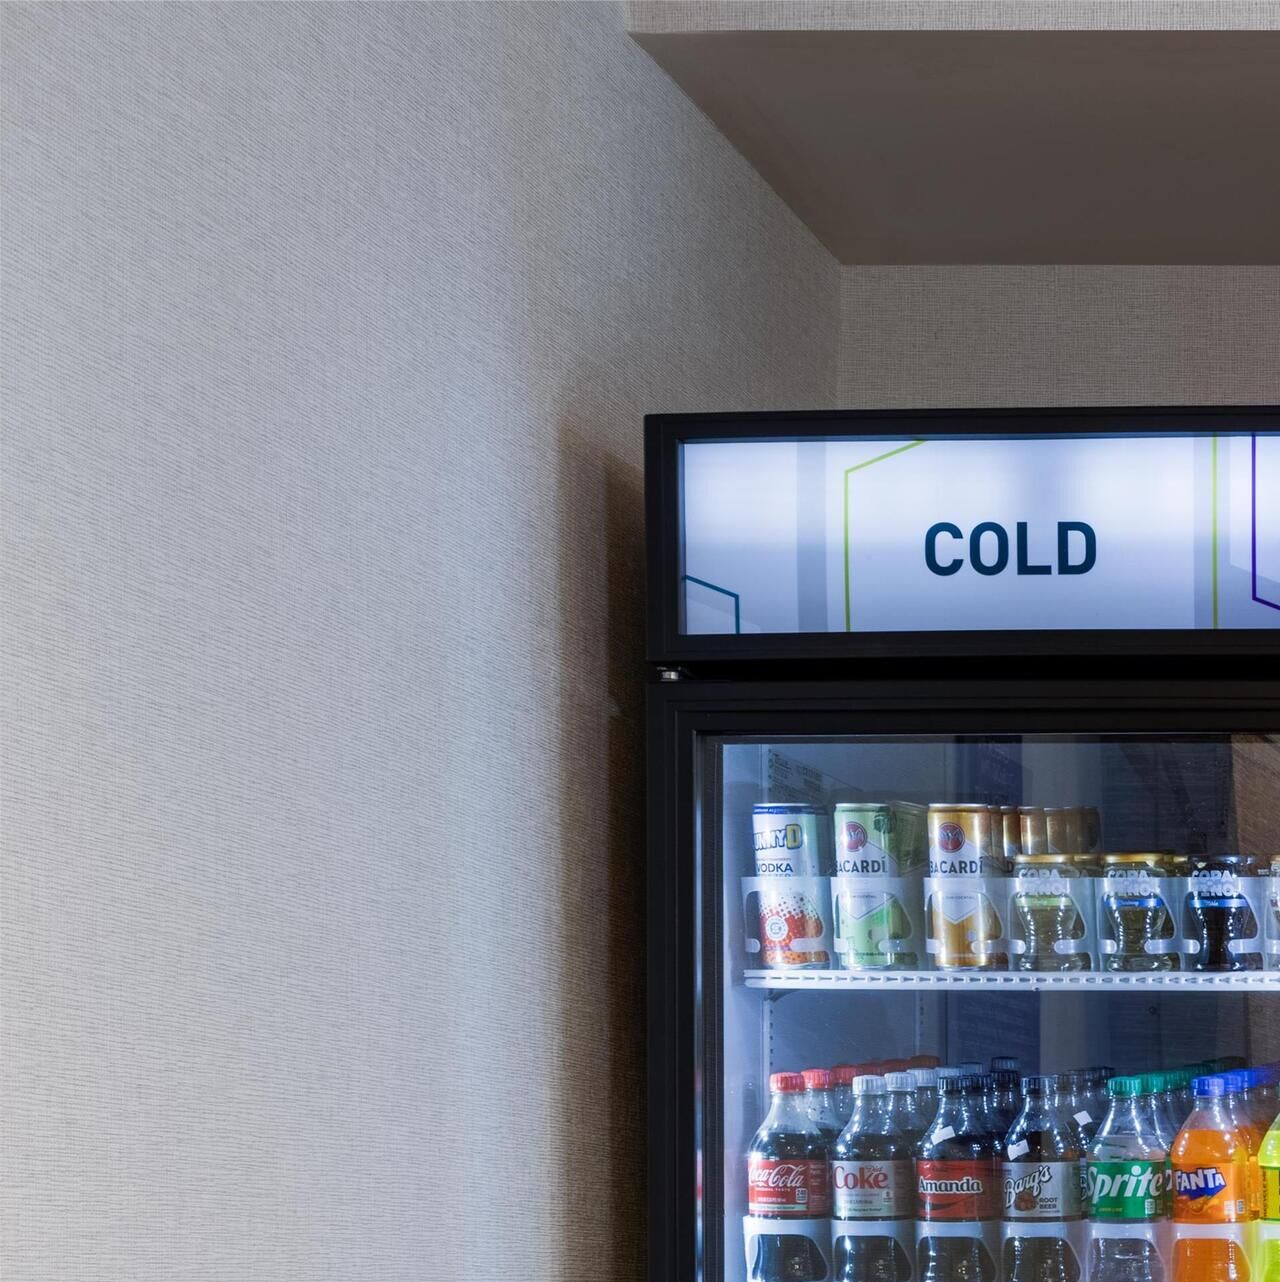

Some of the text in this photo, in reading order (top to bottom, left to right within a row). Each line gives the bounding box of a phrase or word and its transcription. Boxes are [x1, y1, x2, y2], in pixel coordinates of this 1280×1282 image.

[923, 520, 1098, 577] COLD
[748, 1164, 806, 1189] Coca-Cola
[833, 1166, 889, 1190] Coke
[918, 1176, 982, 1194] Amanda
[1004, 1165, 1052, 1208] Barq's
[1086, 1164, 1164, 1198] Sprite
[1174, 1167, 1226, 1190] FANTA
